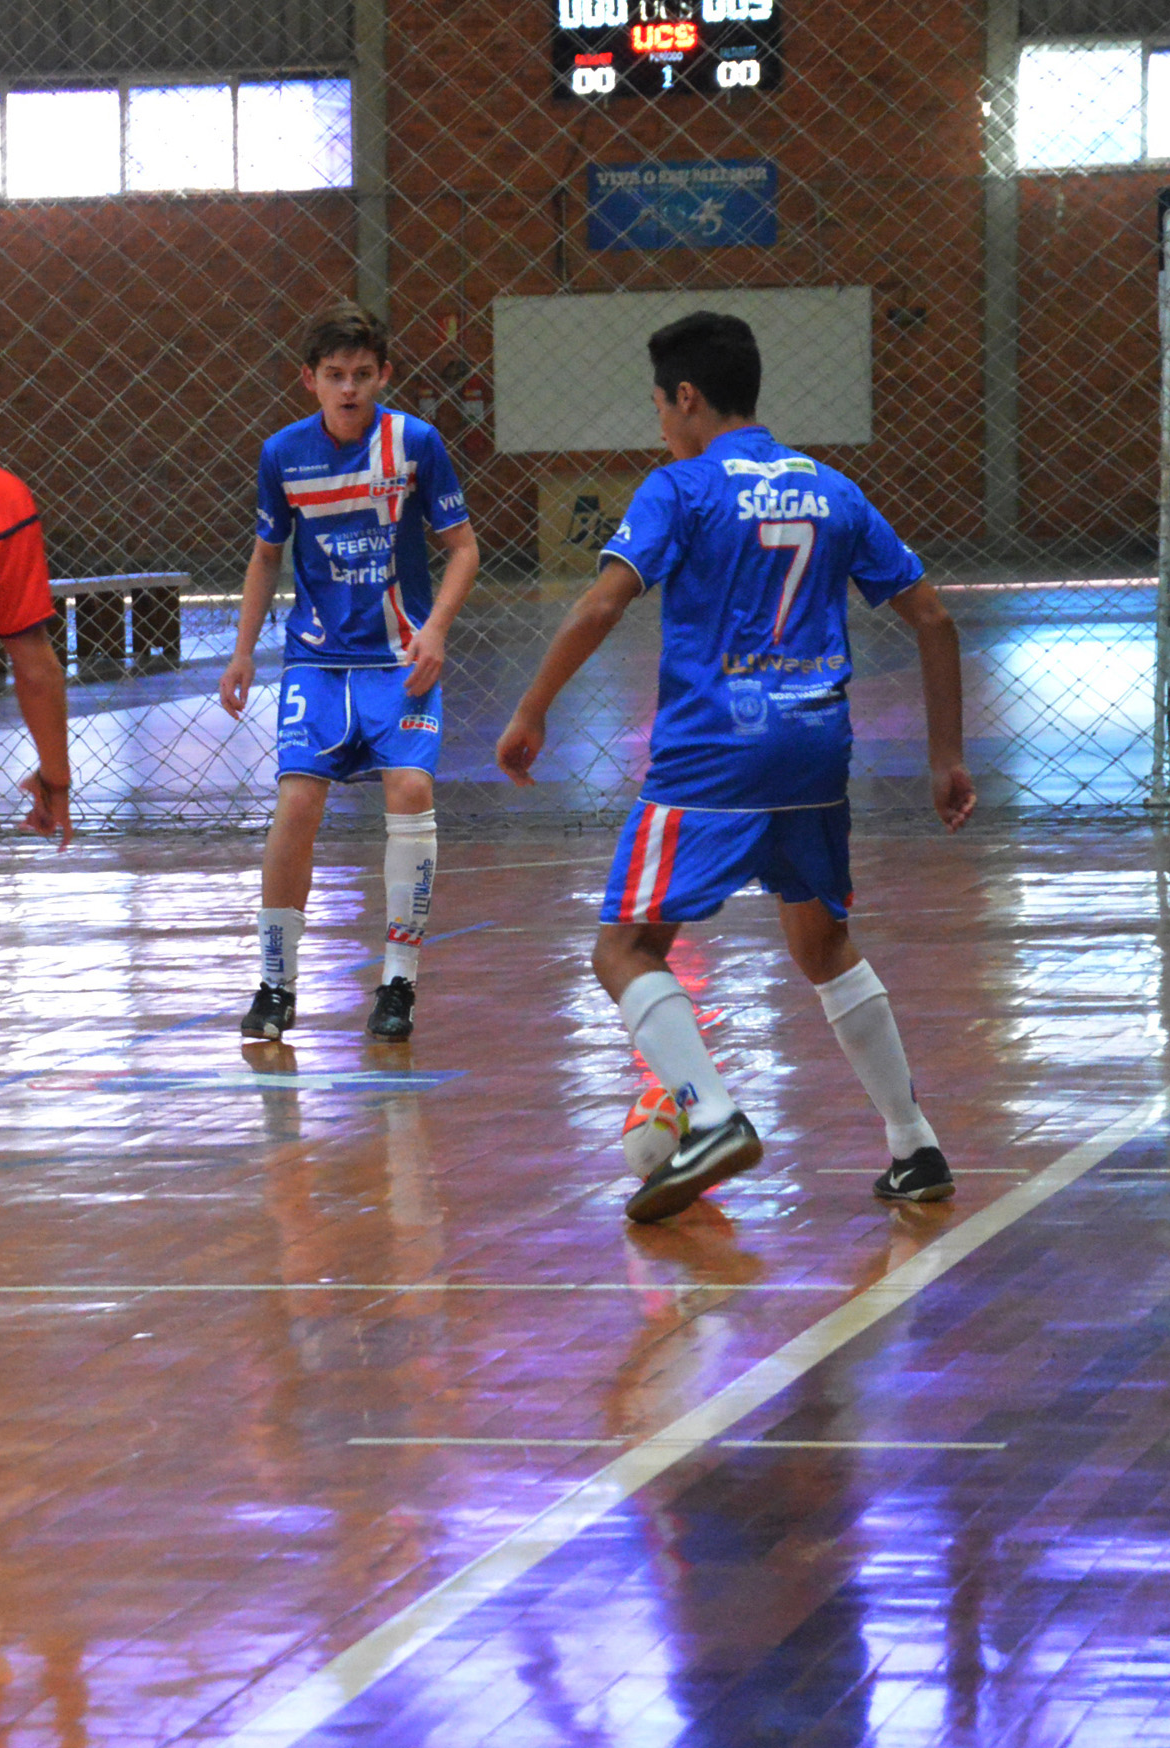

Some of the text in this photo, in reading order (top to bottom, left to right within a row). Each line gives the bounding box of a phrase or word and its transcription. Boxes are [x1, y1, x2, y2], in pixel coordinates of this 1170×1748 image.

[631, 22, 698, 51] UCS
[572, 66, 616, 95] 00
[661, 65, 674, 89] 1
[716, 59, 761, 88] 00
[758, 520, 816, 646] 7
[283, 684, 307, 726] 5
